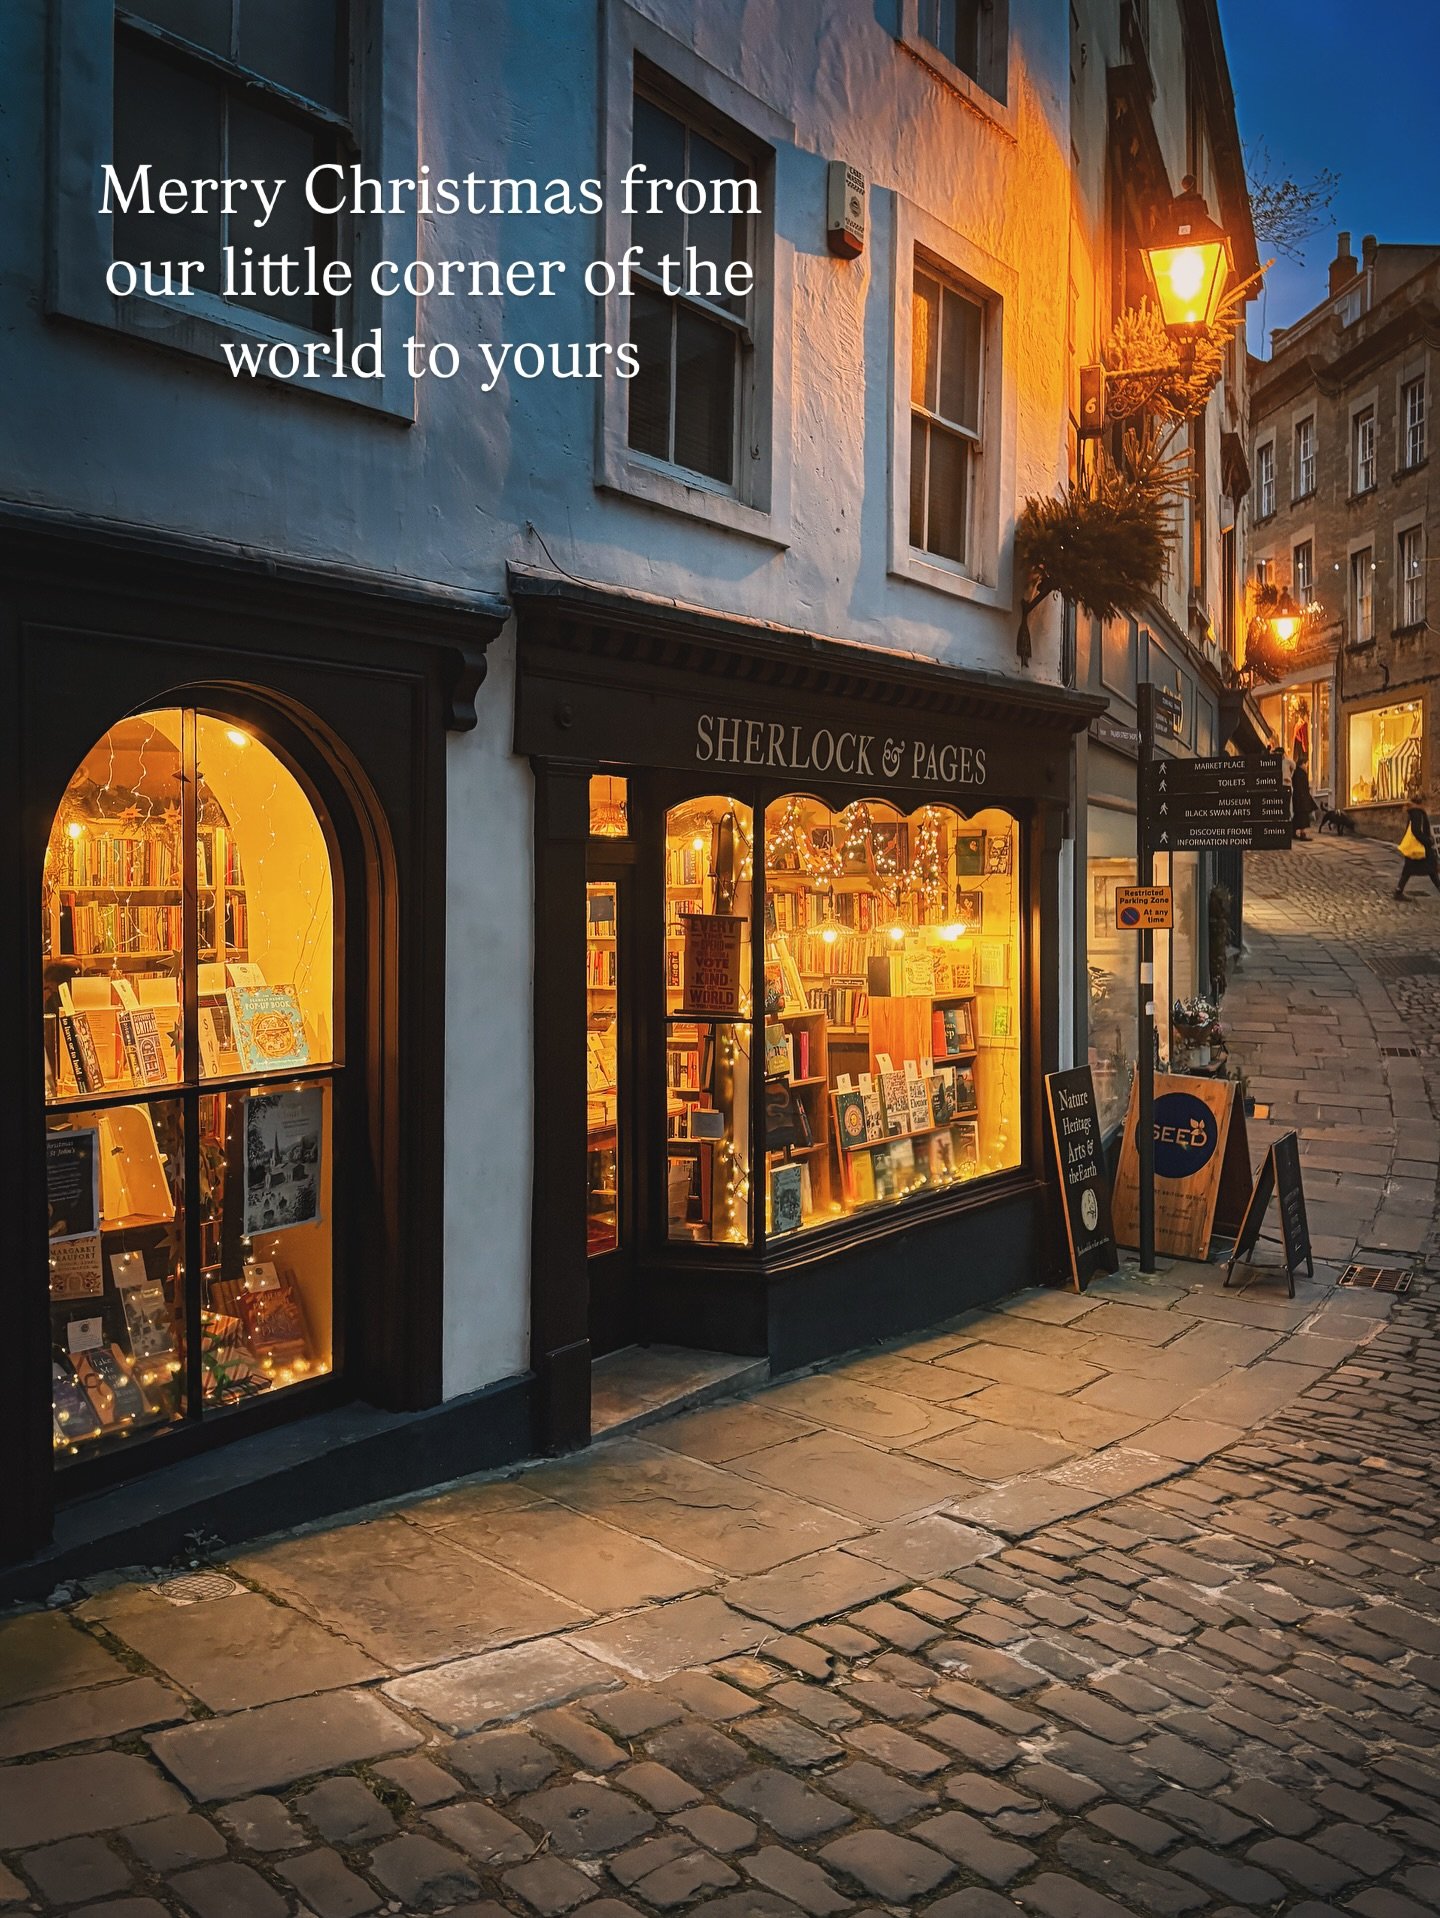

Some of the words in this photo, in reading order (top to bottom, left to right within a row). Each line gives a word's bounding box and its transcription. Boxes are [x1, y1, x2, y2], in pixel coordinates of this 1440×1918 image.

[696, 714, 875, 776] SHERLOCK
[882, 737, 905, 777] &
[911, 741, 986, 785] PAGES
[1194, 761, 1222, 770] MARKET
[1223, 760, 1245, 769] PLACE
[1218, 779, 1246, 787] TOILETS
[1256, 777, 1277, 785] 5mins
[1218, 799, 1251, 807] MUSEUM
[1262, 798, 1284, 806] 5mins
[1185, 809, 1208, 817] BLACK
[1209, 808, 1231, 816] SWAN
[1232, 808, 1251, 816] ARTS
[1262, 807, 1284, 815] 5mins
[1189, 828, 1226, 836] DISCOVER
[1226, 827, 1253, 836] FROME
[1263, 827, 1286, 835] 5mins
[1177, 838, 1229, 846] INFORMATION
[691, 920, 735, 933] EVERY
[696, 958, 728, 968] VOTE
[696, 972, 728, 986] KIND
[690, 990, 734, 1005] WORLD
[245, 1002, 269, 1010] POP-UP
[270, 1001, 290, 1009] BOOK
[73, 1059, 83, 1075] hold
[1058, 1089, 1088, 1111] Nature
[1062, 1117, 1092, 1136] Heritage
[1153, 1124, 1208, 1147] SEED
[1068, 1141, 1086, 1164] Arts
[1086, 1139, 1094, 1156] &
